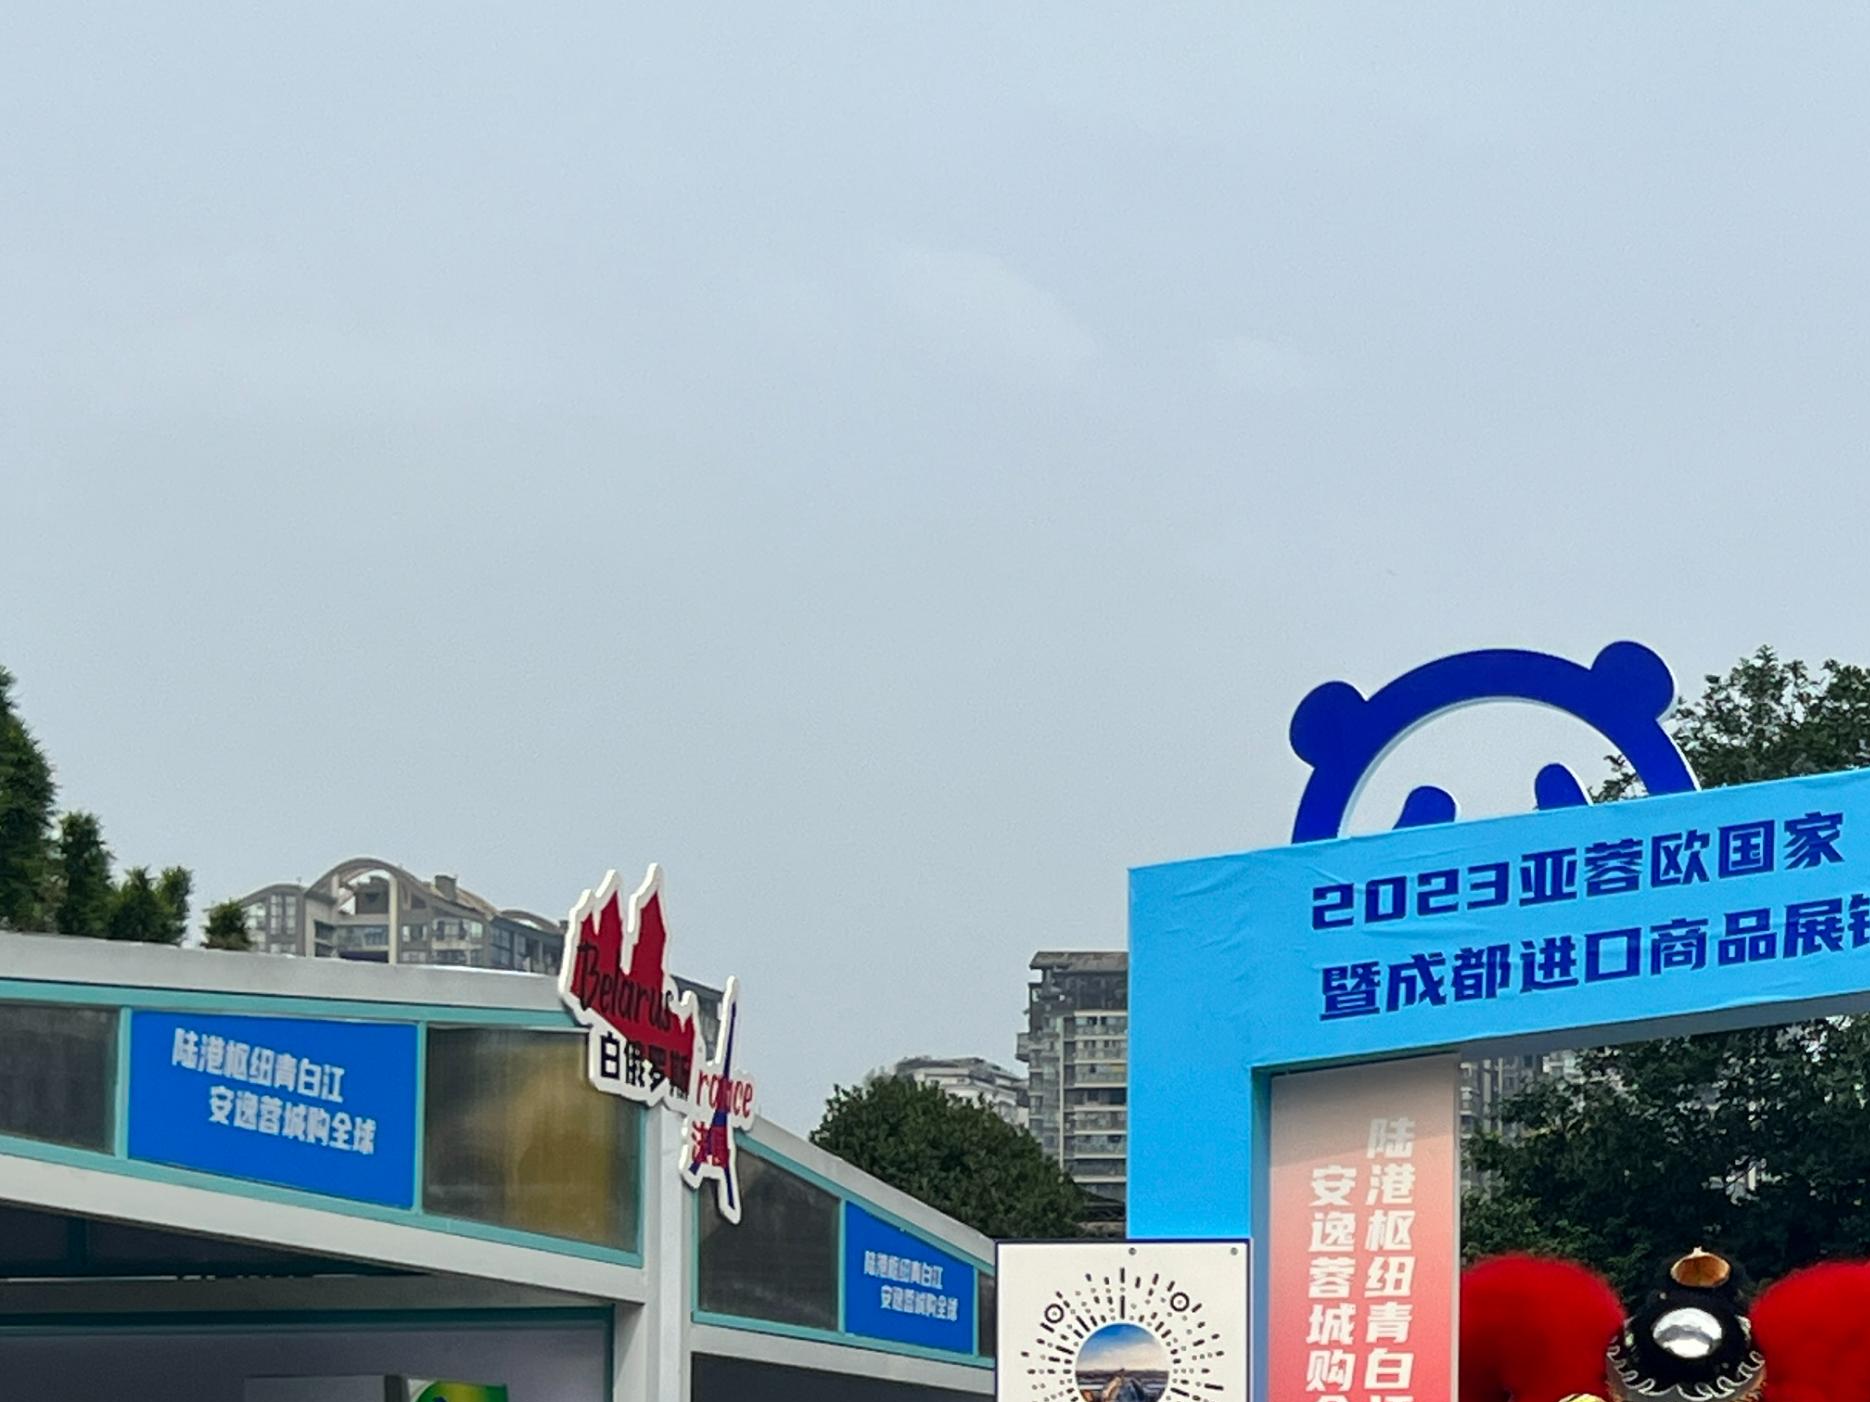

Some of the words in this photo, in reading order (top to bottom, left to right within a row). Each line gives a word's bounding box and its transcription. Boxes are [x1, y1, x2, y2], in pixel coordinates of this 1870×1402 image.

[577, 942, 674, 1031] Belarus
[171, 1027, 345, 1104] 陆港枢纽青白江
[695, 1069, 753, 1119] rance
[208, 1084, 376, 1155] 安逸蓉城购全球
